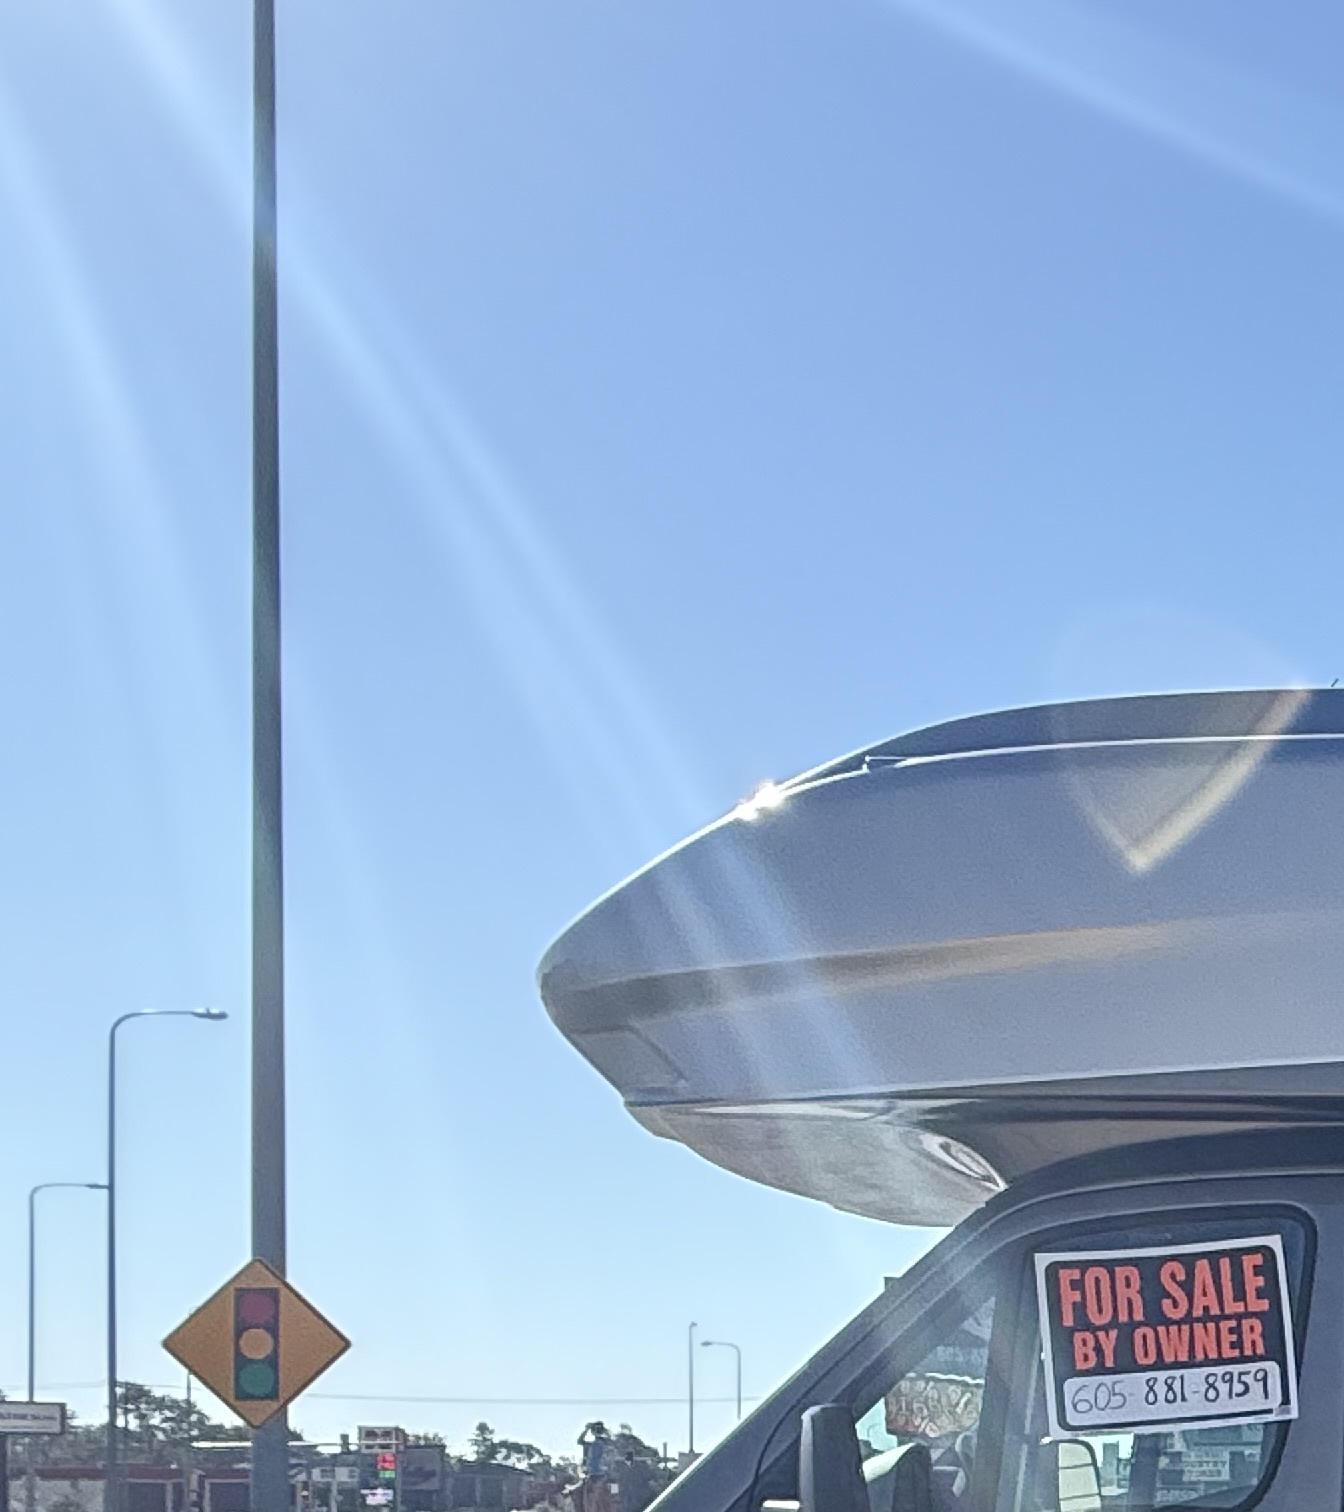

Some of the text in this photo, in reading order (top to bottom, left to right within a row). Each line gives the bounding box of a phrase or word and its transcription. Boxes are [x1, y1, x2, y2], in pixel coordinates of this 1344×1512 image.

[1058, 1253, 1270, 1327] FOR SALE
[1073, 1318, 1266, 1370] BY OWNER
